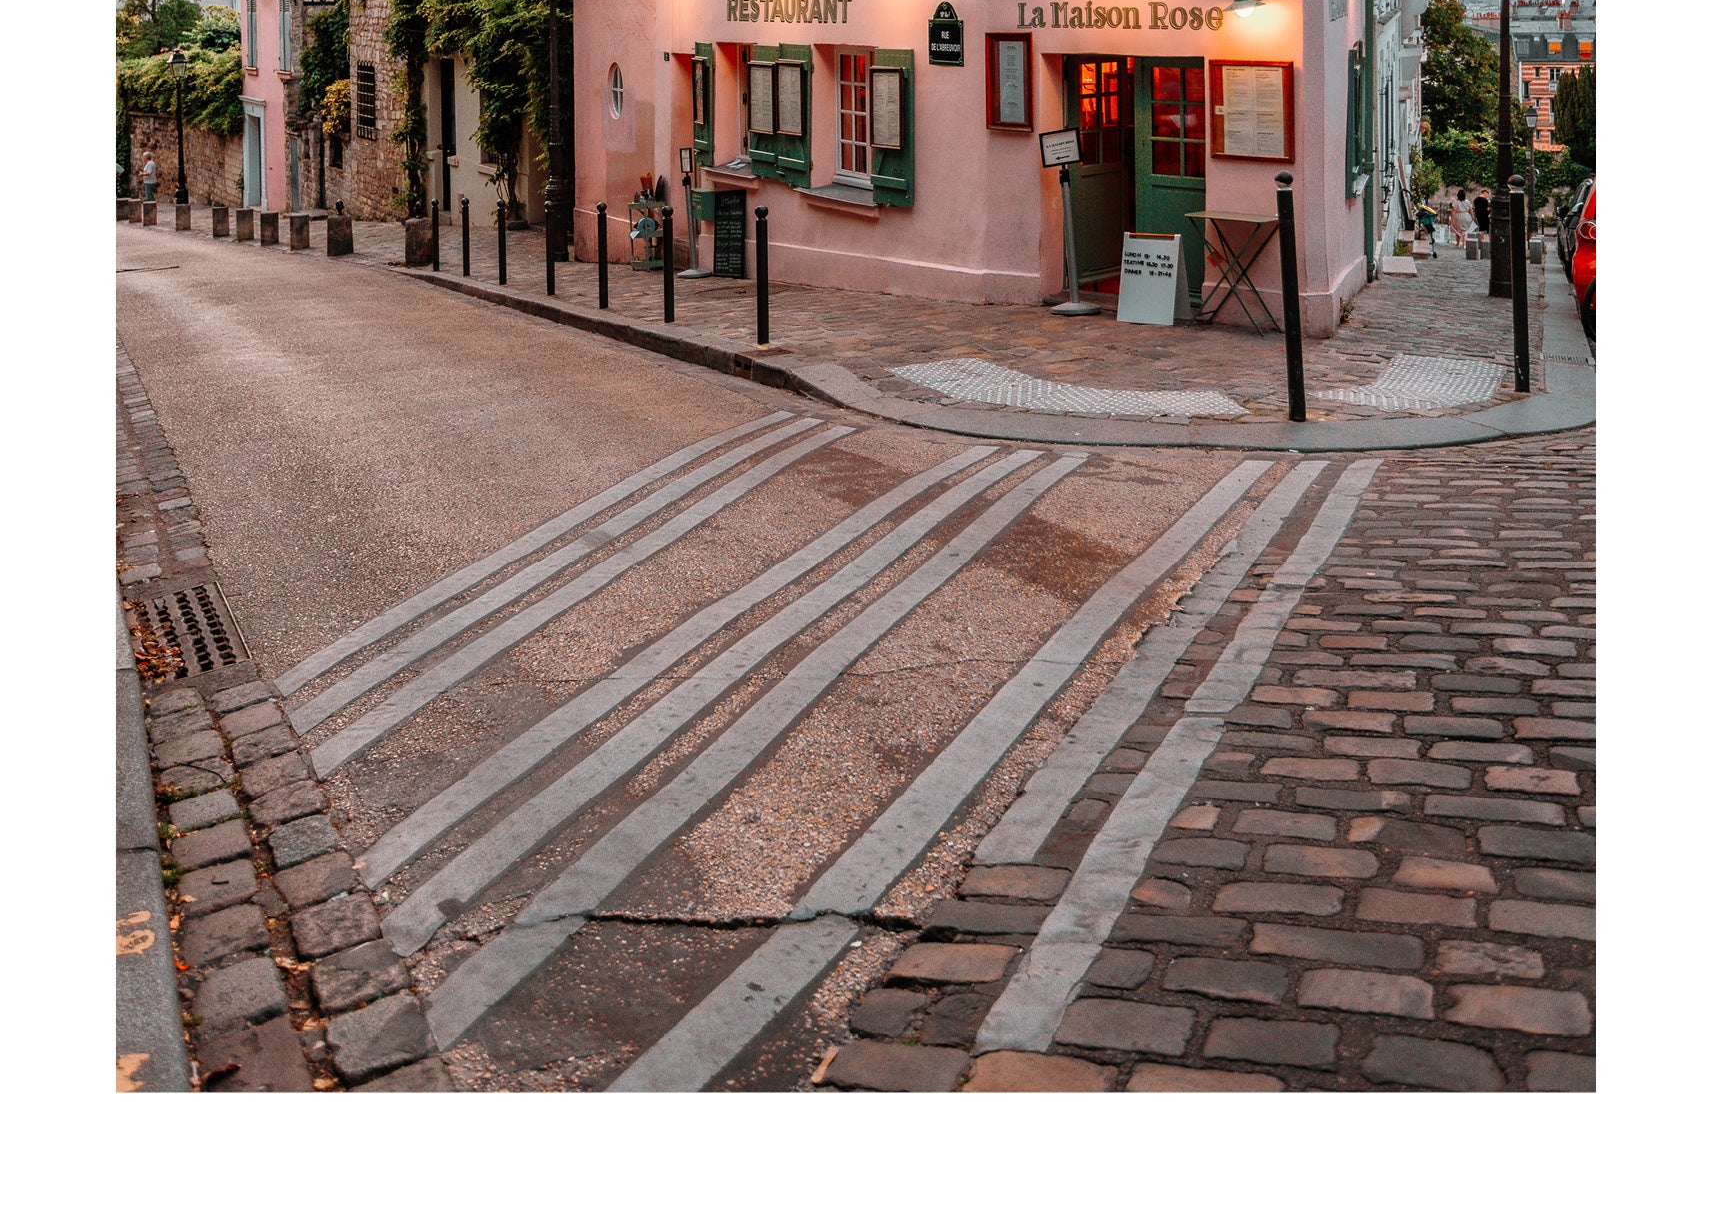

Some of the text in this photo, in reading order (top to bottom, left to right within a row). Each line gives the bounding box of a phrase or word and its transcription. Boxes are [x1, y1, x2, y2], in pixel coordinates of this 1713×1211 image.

[1017, 0, 1224, 31] La Maison Rose
[941, 31, 949, 39] RUE
[931, 42, 937, 51] DE
